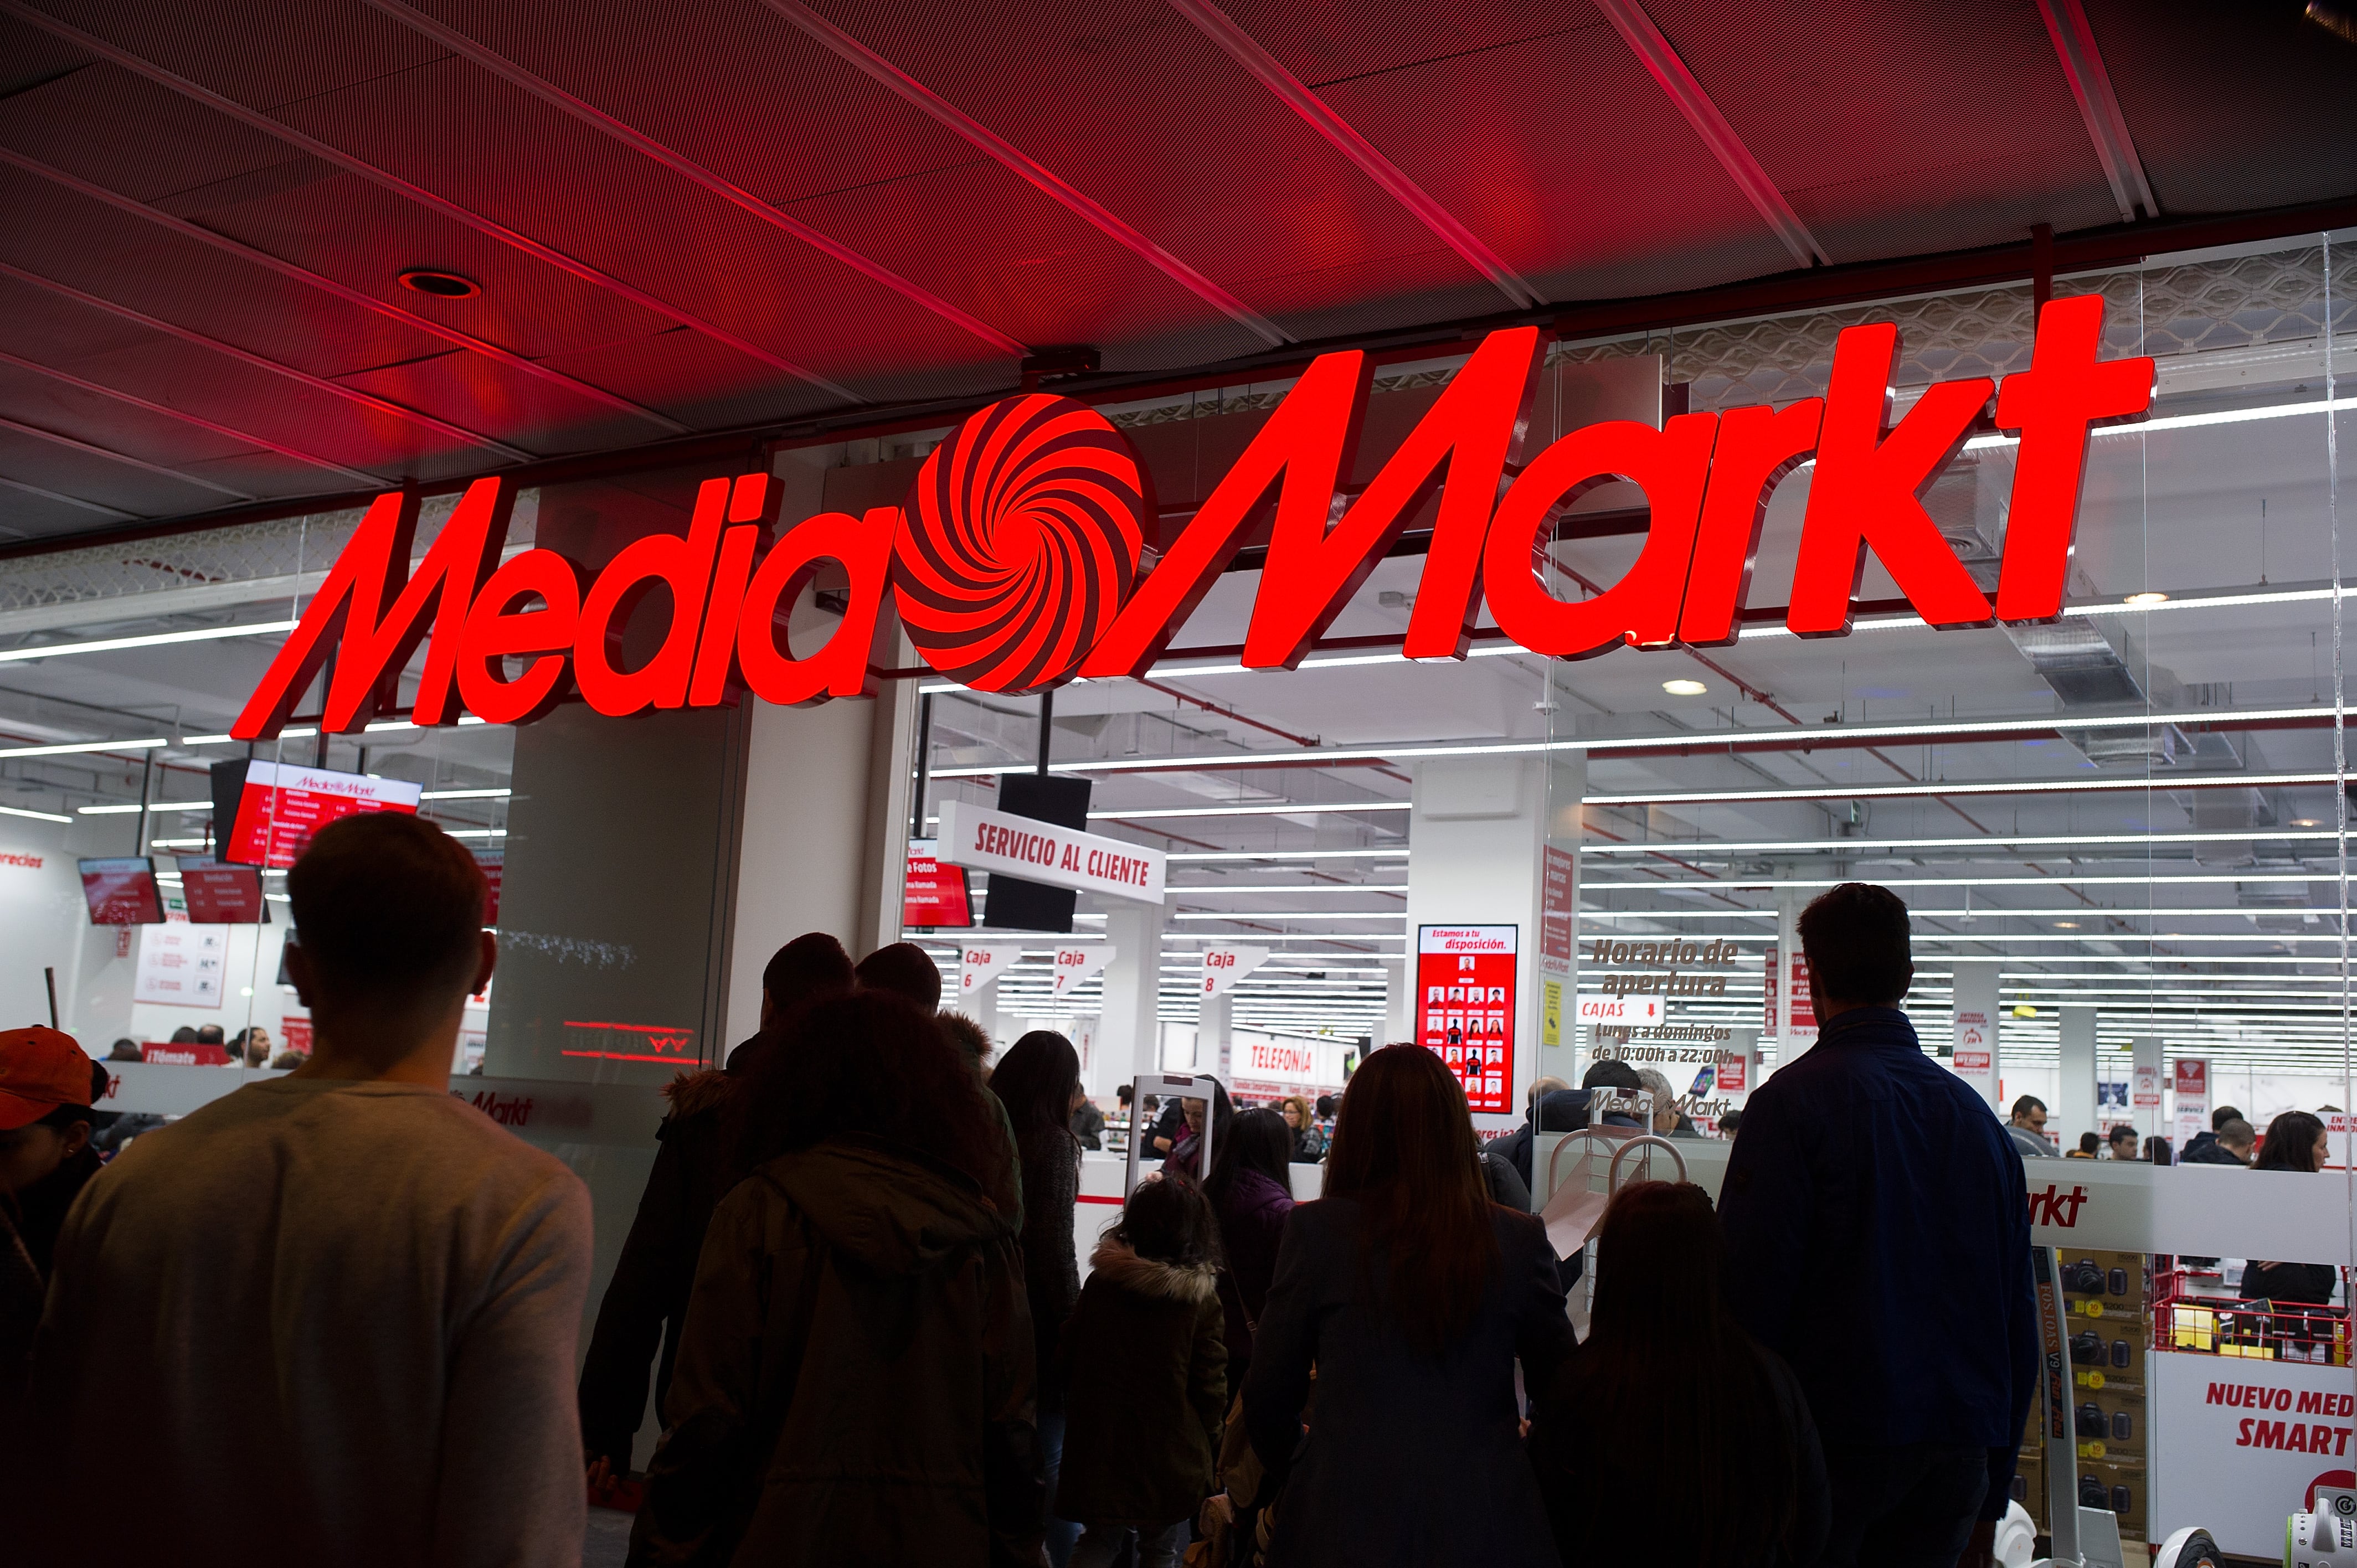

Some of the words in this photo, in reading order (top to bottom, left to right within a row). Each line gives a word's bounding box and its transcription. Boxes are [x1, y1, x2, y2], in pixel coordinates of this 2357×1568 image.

[229, 472, 899, 739] Media
[1077, 293, 2155, 678] Markt
[975, 822, 1056, 866] SERVICIO
[1060, 844, 1080, 872] AL
[1088, 849, 1150, 887] CLIENTE
[913, 862, 938, 874] Fotos
[1445, 938, 1507, 951] disposición.
[1592, 938, 1697, 964] Horario
[1703, 938, 1738, 965] de
[966, 950, 991, 966] Caja
[1058, 951, 1085, 967] Caja
[1206, 951, 1235, 969] Caja
[964, 973, 972, 987] 6
[1056, 975, 1065, 989] 7
[1205, 977, 1214, 992] 8
[1602, 971, 1727, 1000] apertura
[1582, 1002, 1625, 1018] CAJAS
[1594, 1023, 1638, 1038] Lunes
[1641, 1027, 1651, 1039] a
[1653, 1024, 1732, 1042] domingos
[1592, 1045, 1610, 1060] de
[1614, 1046, 1665, 1062] 10:00h
[1668, 1051, 1677, 1062] a
[1679, 1049, 1735, 1064] 22:00h
[1582, 1090, 1654, 1114] Media
[1668, 1094, 1732, 1116] Markt
[2026, 1184, 2088, 1228] rkt
[2049, 1352, 2060, 1369] V9
[2206, 1382, 2292, 1411] NUEVO
[2296, 1390, 2354, 1417] MED
[2236, 1418, 2354, 1456] SMART
